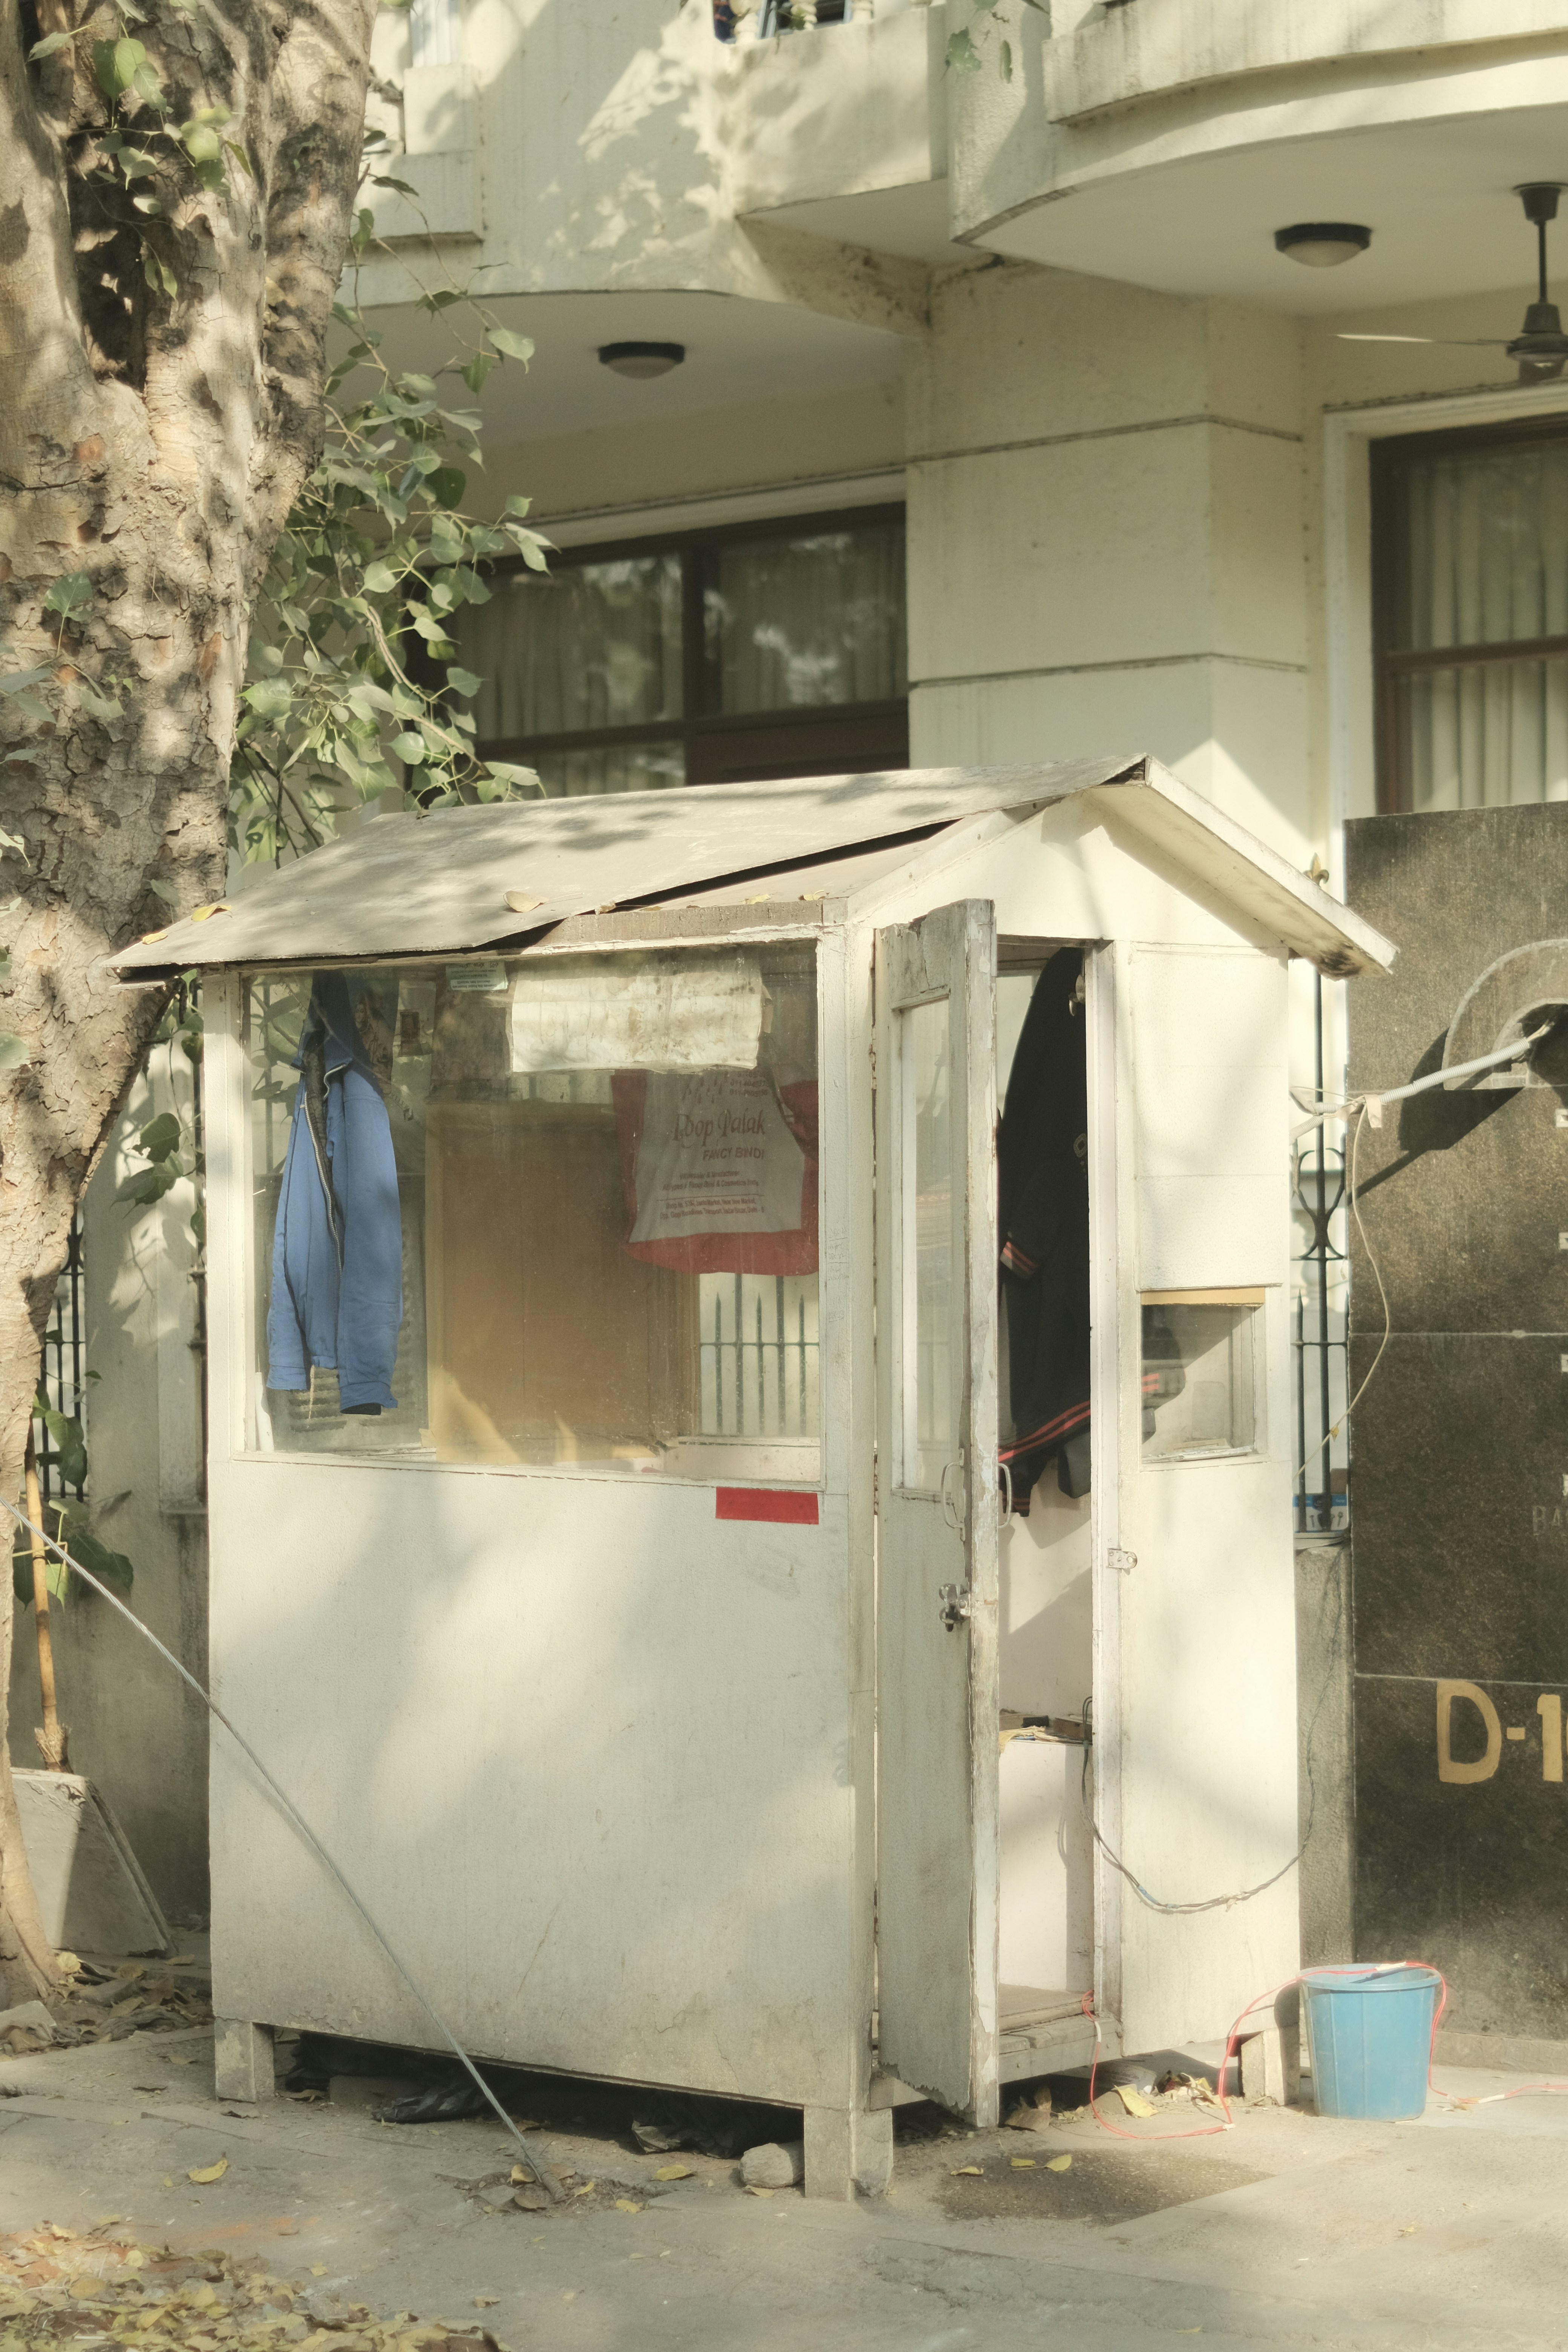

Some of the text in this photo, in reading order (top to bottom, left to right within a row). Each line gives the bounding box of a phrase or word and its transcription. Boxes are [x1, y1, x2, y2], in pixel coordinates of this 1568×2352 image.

[672, 1108, 766, 1148] Roop Palak
[703, 1147, 765, 1161] FANCY BINDI
[1436, 1680, 1568, 1784] D-1
